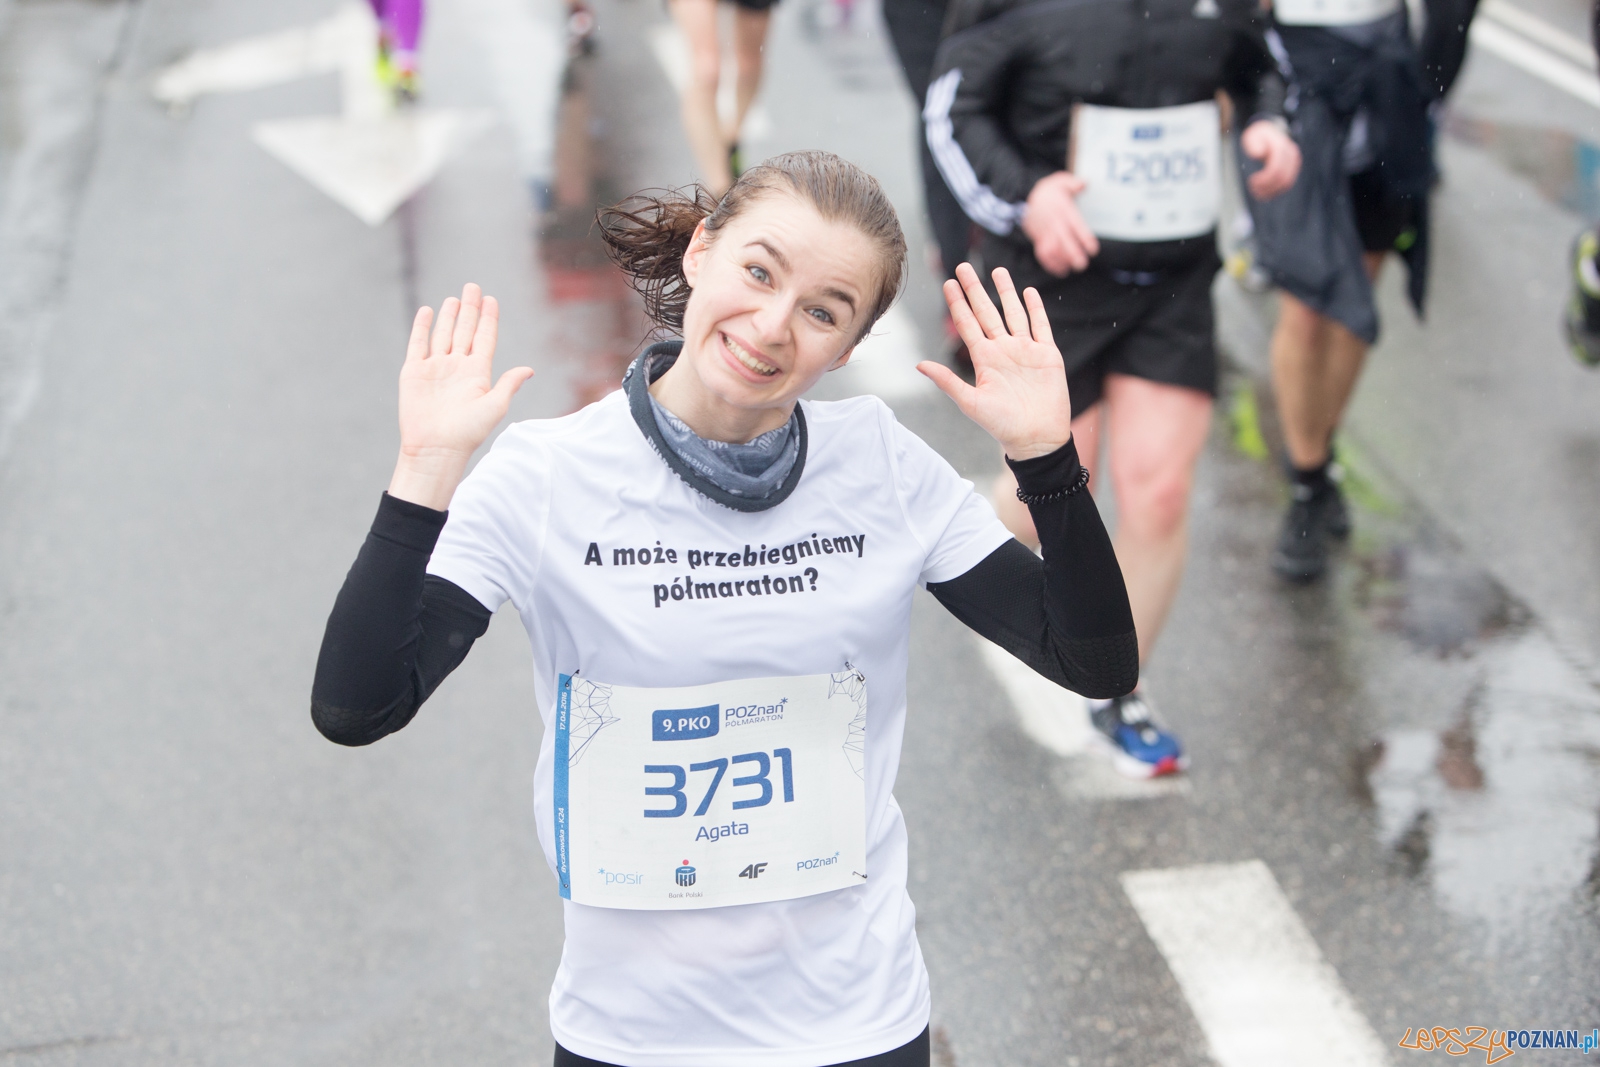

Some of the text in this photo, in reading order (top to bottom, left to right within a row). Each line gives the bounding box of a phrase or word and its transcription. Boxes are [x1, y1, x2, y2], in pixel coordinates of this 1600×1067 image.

[584, 533, 866, 570] A może przebiegniemy
[653, 567, 819, 608] półmaraton?
[662, 715, 711, 732] 9. PKO
[643, 747, 795, 818] 3731
[695, 821, 749, 842] Agata
[738, 862, 768, 879] 4F
[685, 891, 703, 899] Polski
